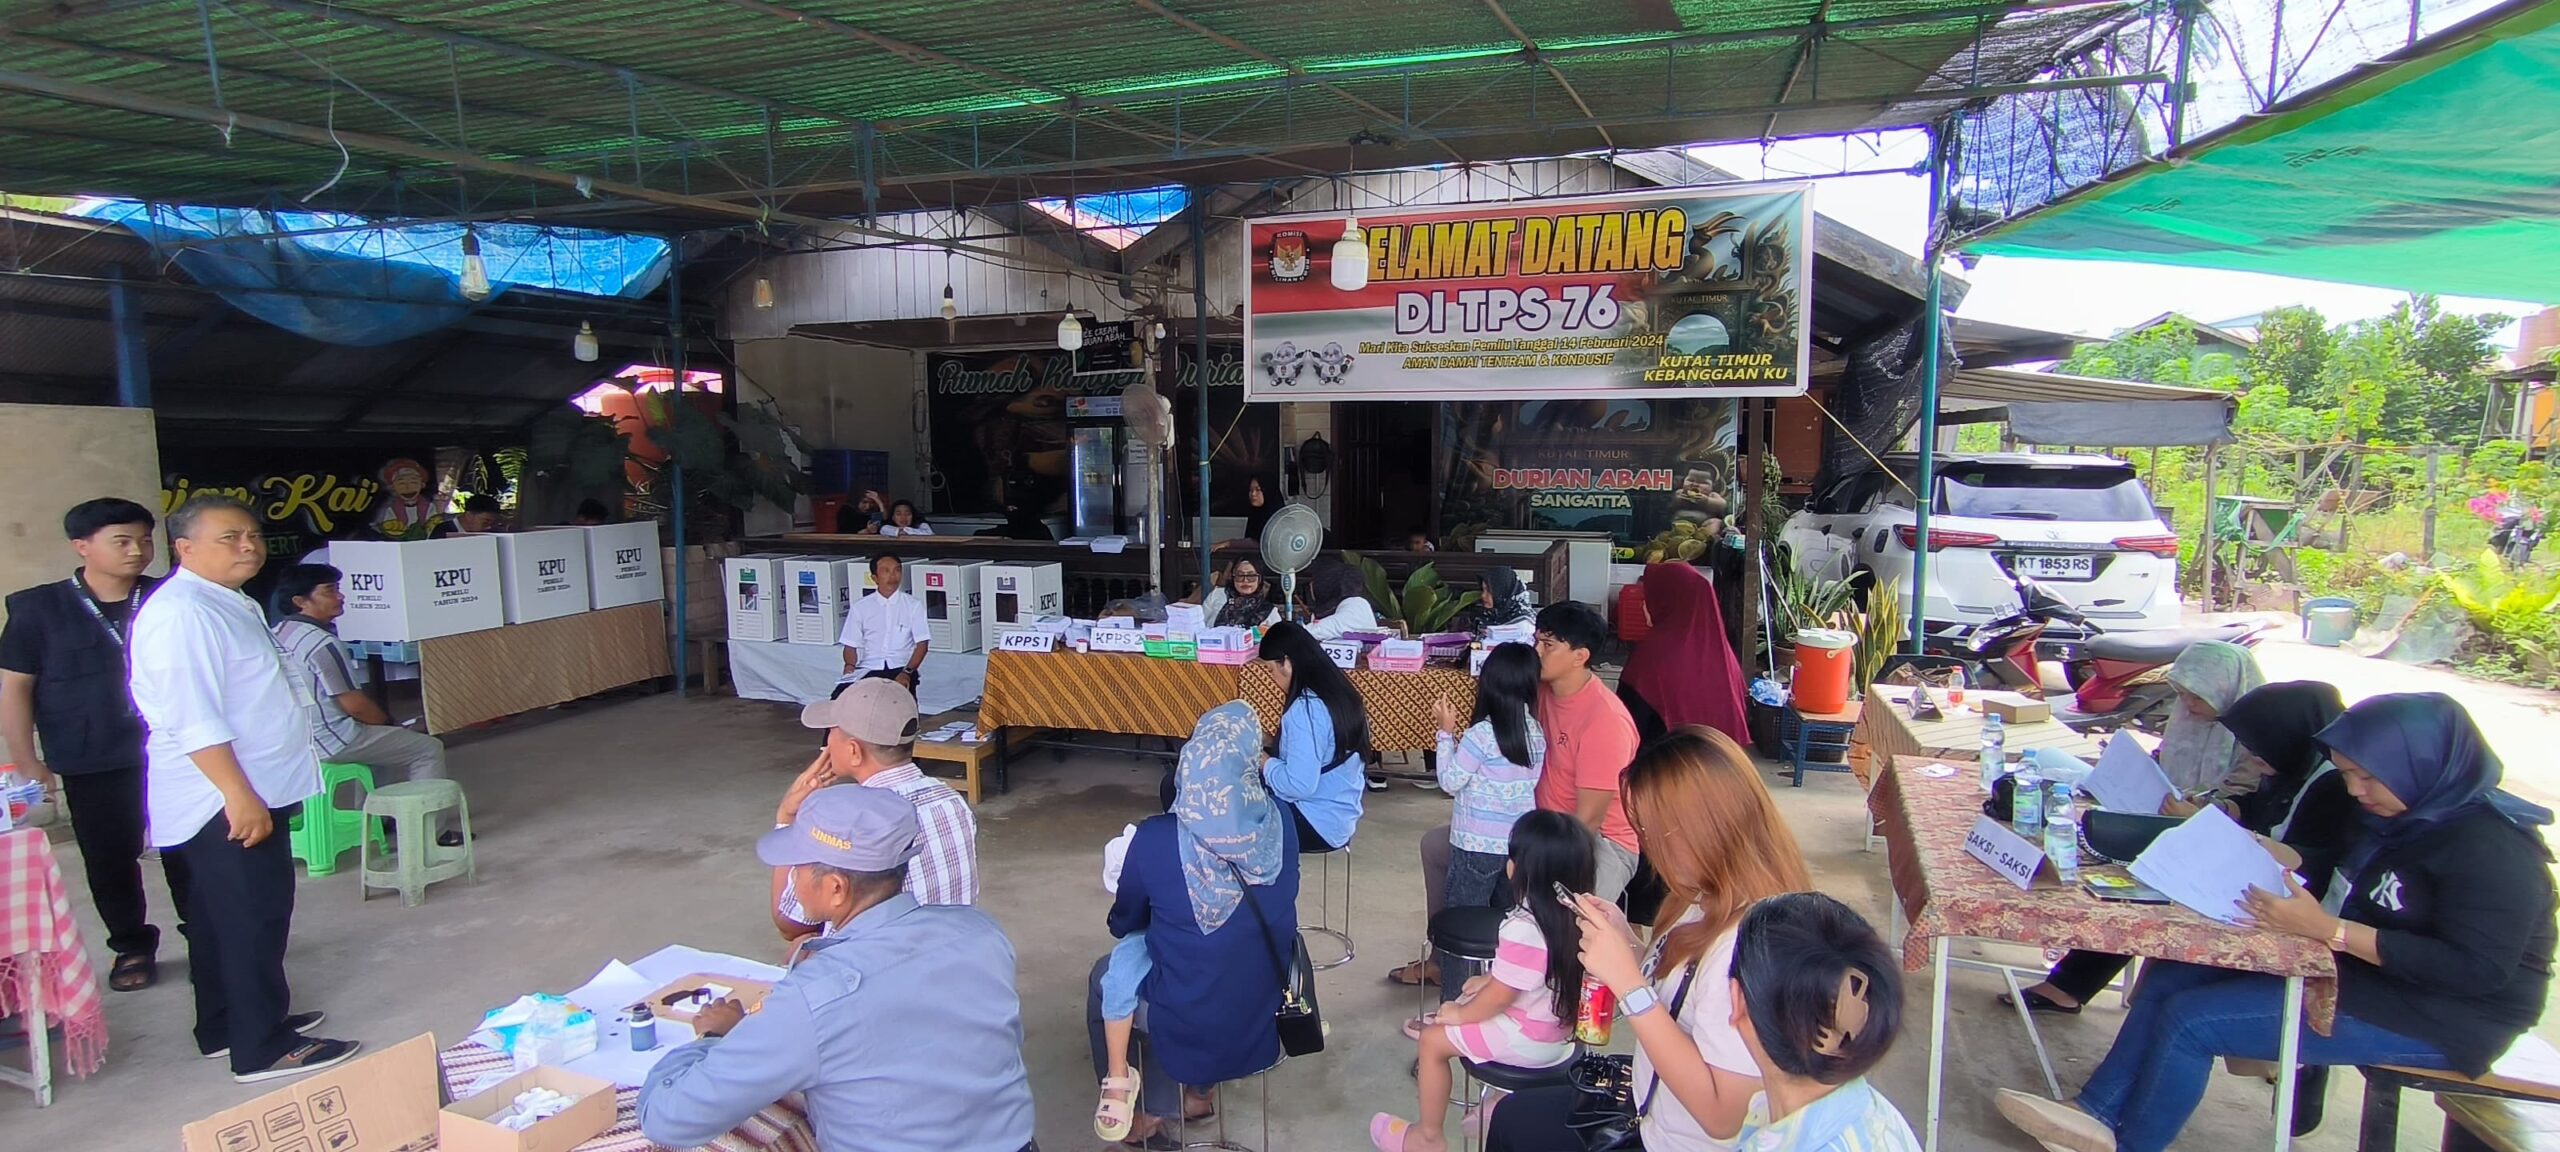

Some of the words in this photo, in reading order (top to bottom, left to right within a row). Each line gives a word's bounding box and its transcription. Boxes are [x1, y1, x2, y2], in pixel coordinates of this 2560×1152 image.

[1357, 217, 1518, 283] ELAMAT
[1519, 207, 1687, 275] DATANG
[1396, 290, 1446, 334] DI
[1457, 286, 1550, 332] TPS
[1562, 284, 1620, 330] 76
[1359, 342, 1385, 354] Mari
[1386, 342, 1408, 353] Kita
[1410, 340, 1470, 353] Sukseskan
[1472, 338, 1512, 351] Pemilu
[1513, 337, 1557, 352] Tanggal
[1560, 337, 1577, 349] 14
[1579, 336, 1630, 349] Februari
[1630, 334, 1664, 348] 2024
[1402, 356, 1437, 369] AMAN
[1439, 356, 1478, 368] DAMAI
[1481, 355, 1537, 368] TENTRAM
[1538, 354, 1549, 366] &
[1551, 353, 1614, 367] KONDUSIF
[1659, 355, 1712, 368] KUTAI
[1717, 354, 1773, 366] TIMUR
[937, 353, 1033, 395] Rumah
[1643, 368, 1759, 382] KEBANGGAAN
[1763, 367, 1788, 380] KU
[1587, 449, 1630, 459] TIMUR
[1492, 468, 1592, 490] DURIAN
[1595, 468, 1673, 491] ABAH
[1530, 493, 1632, 509] SANGATTA
[616, 548, 641, 564] KPU
[2019, 557, 2036, 569] KT
[2038, 558, 2070, 570] 1853
[2072, 559, 2089, 571] RS
[537, 559, 566, 577] KPU
[351, 574, 384, 591] KPU
[434, 568, 472, 588] KPU
[1040, 592, 1058, 611] KPU
[1004, 636, 1040, 647] KPPS
[1043, 637, 1049, 648] 1
[1096, 632, 1132, 644] KPPS
[1134, 633, 1144, 645] 2
[1345, 650, 1354, 660] 3
[811, 826, 852, 850] LINMAS
[1967, 830, 1996, 855] SAKSI
[1999, 852, 2032, 879] SAKSI
